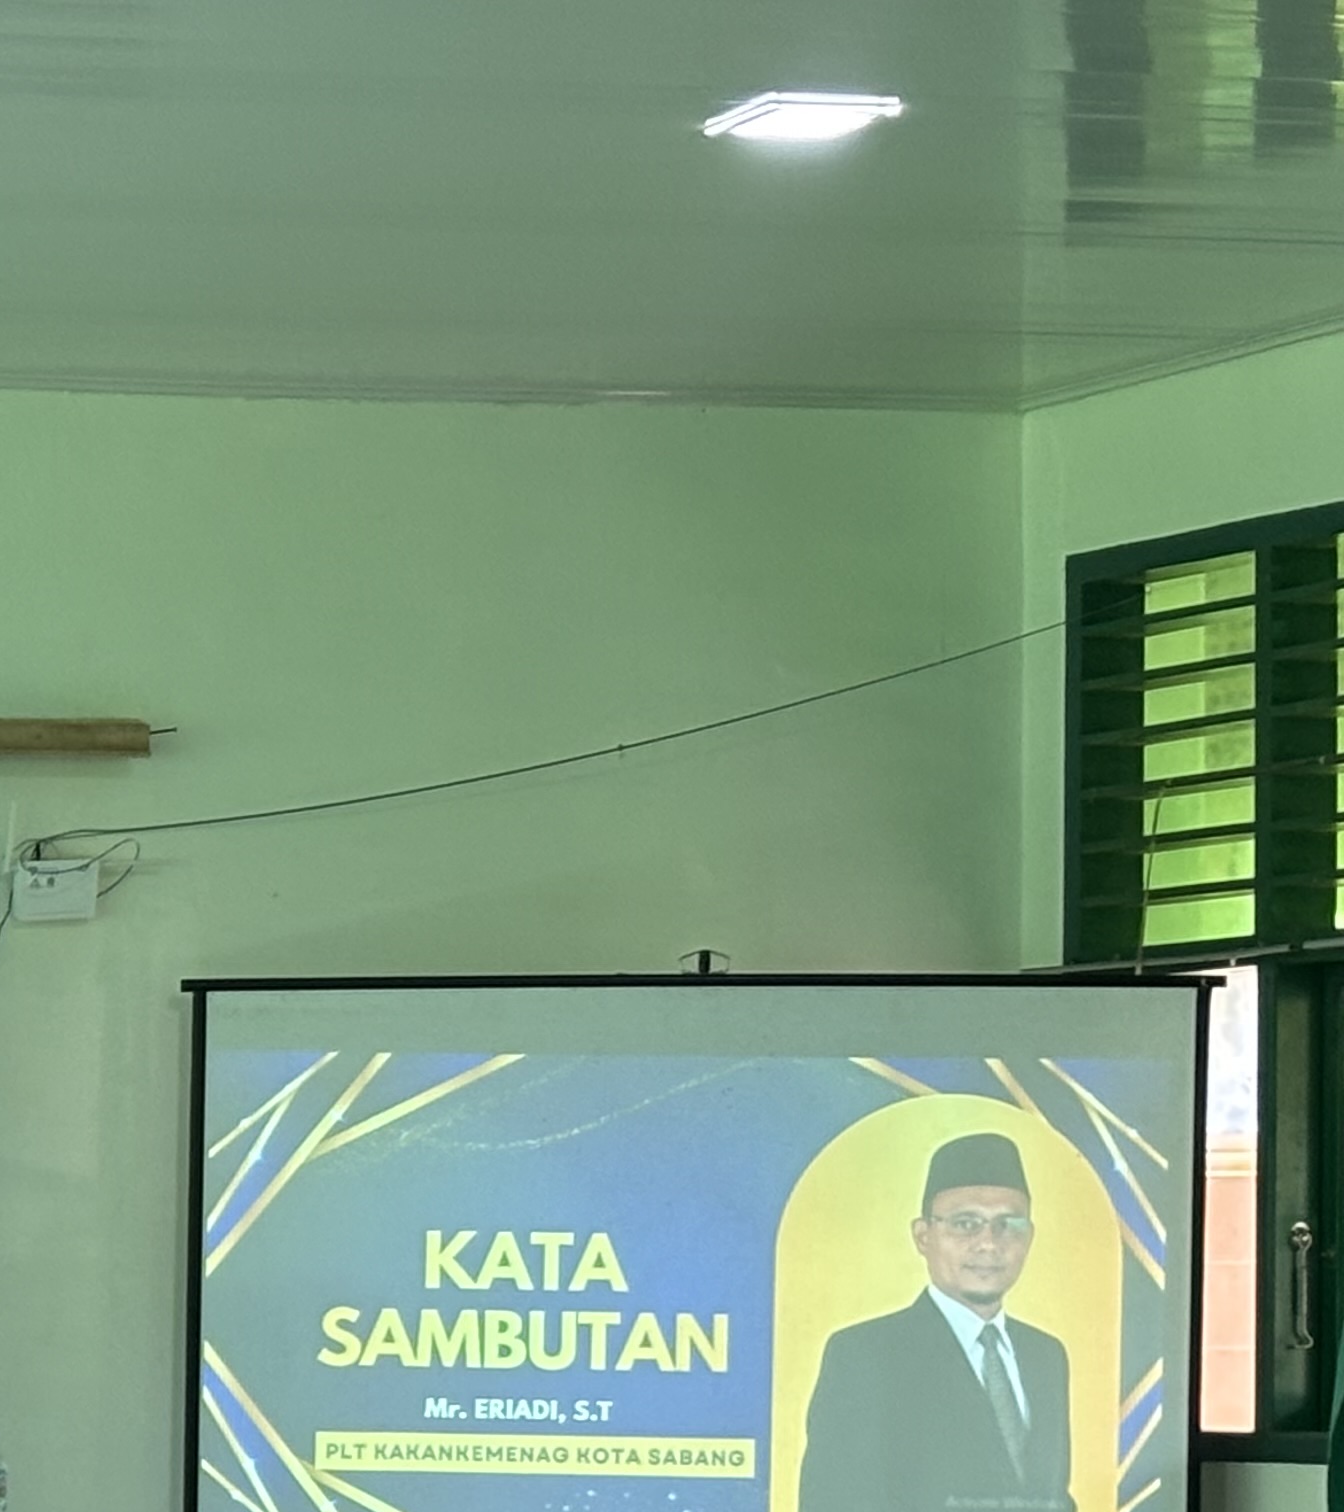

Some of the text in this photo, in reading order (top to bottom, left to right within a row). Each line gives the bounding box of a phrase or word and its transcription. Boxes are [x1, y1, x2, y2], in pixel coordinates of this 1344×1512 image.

[424, 1229, 630, 1293] KATA
[316, 1305, 729, 1373] SAMBUTAN
[423, 1397, 614, 1425] Mr. ERIADI, S.T
[325, 1443, 746, 1468] PLT KAKANKEMENAG KOTA SABANG
